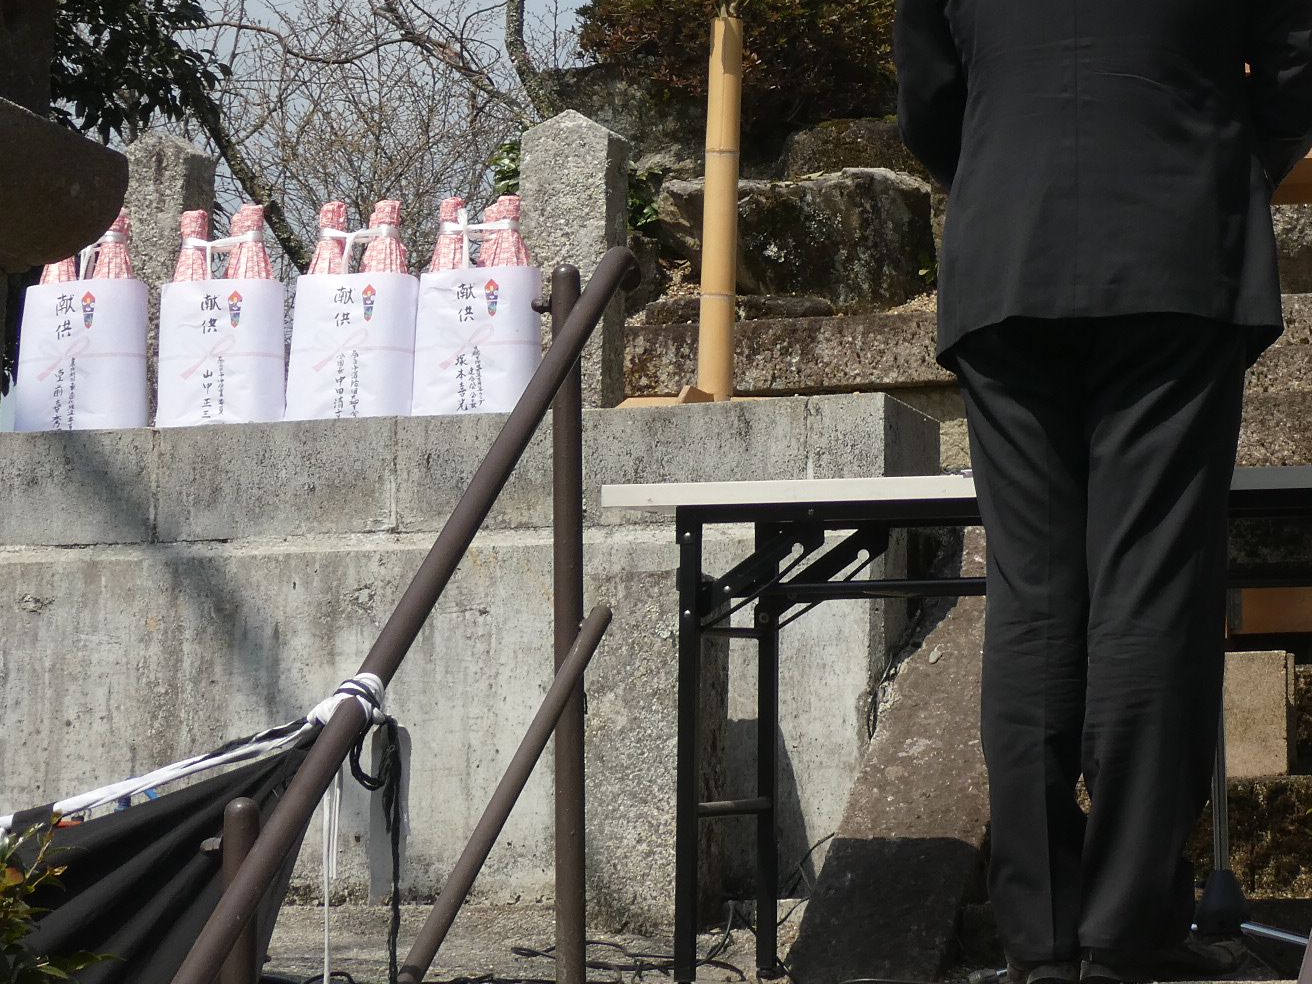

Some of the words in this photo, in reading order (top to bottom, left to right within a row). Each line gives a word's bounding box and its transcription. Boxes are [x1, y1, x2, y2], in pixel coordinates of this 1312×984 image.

[54, 293, 77, 340] 献供
[200, 292, 223, 335] 献供
[333, 285, 355, 328] 献供
[456, 281, 477, 323] 献供
